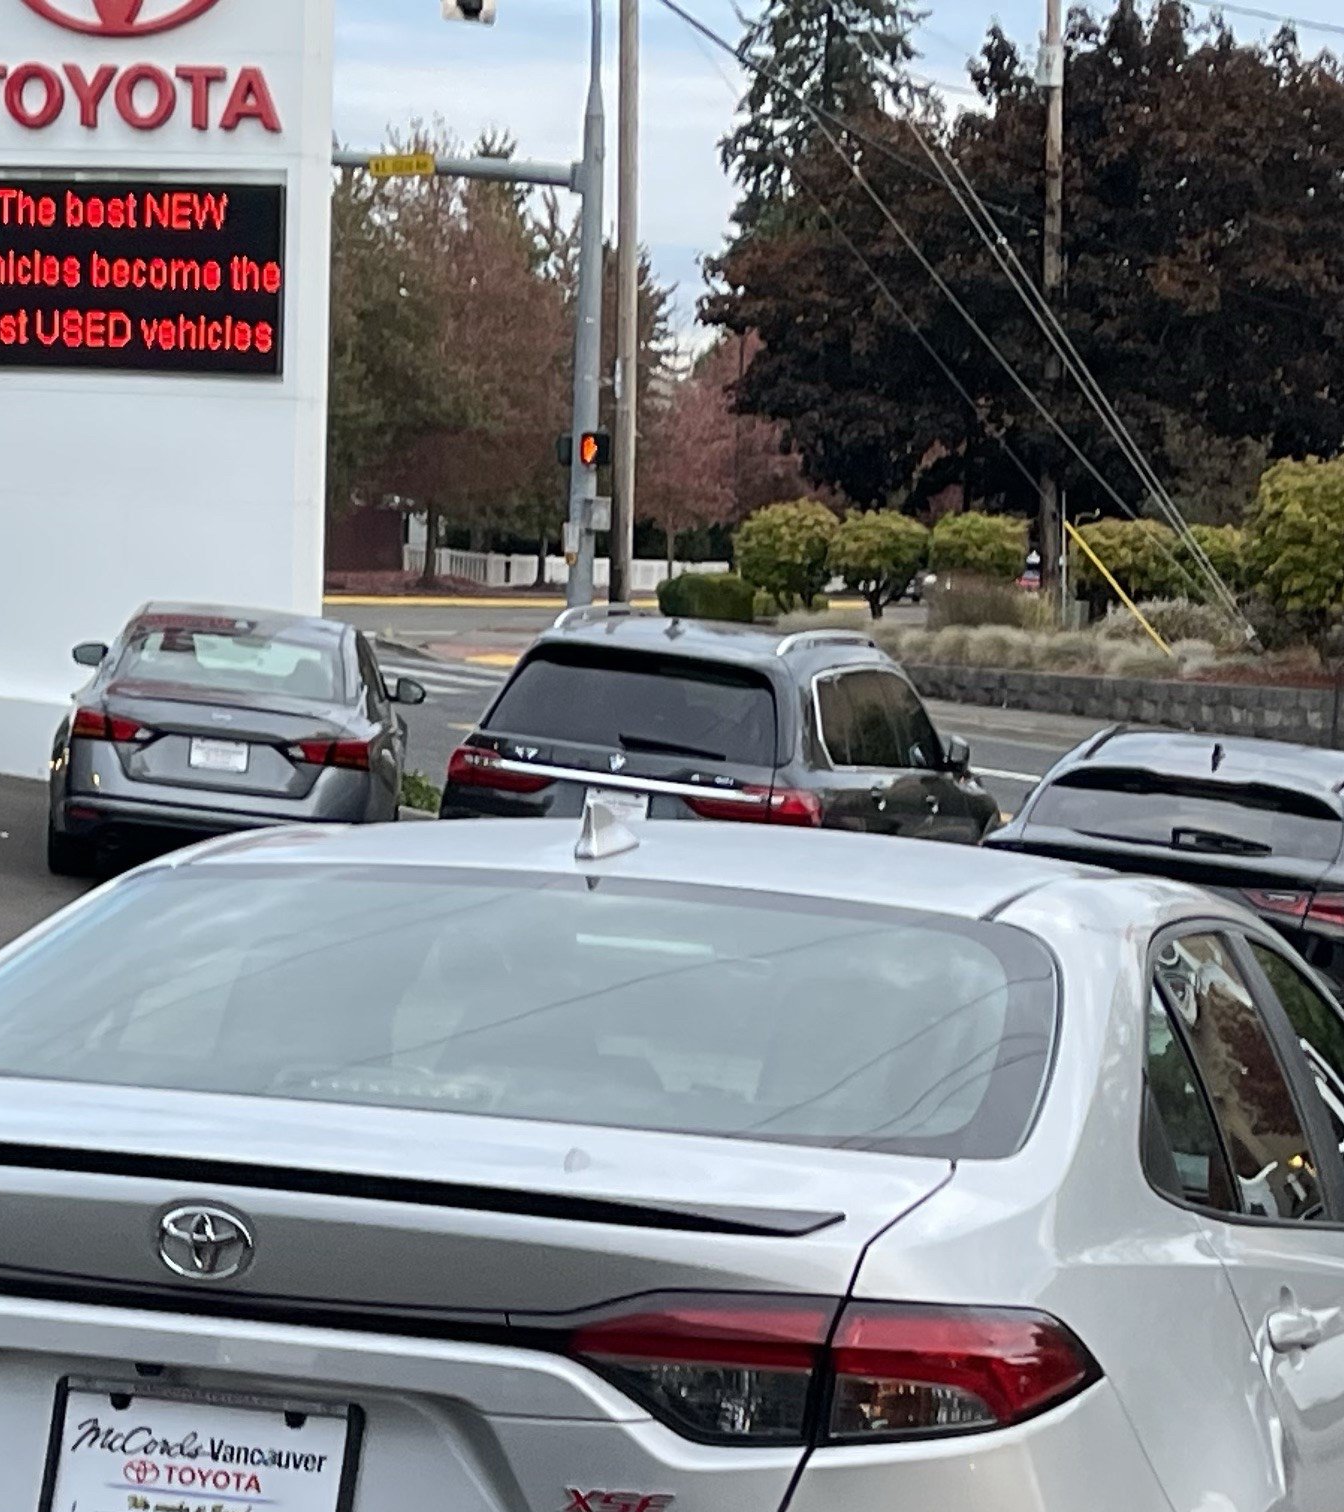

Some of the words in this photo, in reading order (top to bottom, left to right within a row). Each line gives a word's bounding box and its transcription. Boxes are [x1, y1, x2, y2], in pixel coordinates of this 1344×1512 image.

[65, 190, 137, 228] best
[144, 191, 228, 230] NEW
[90, 251, 221, 291] become
[230, 255, 281, 293] the
[36, 308, 131, 348] USED
[141, 314, 273, 353] vehicles
[208, 1437, 327, 1473] Vancouver
[164, 1464, 262, 1493] TOYOTA
